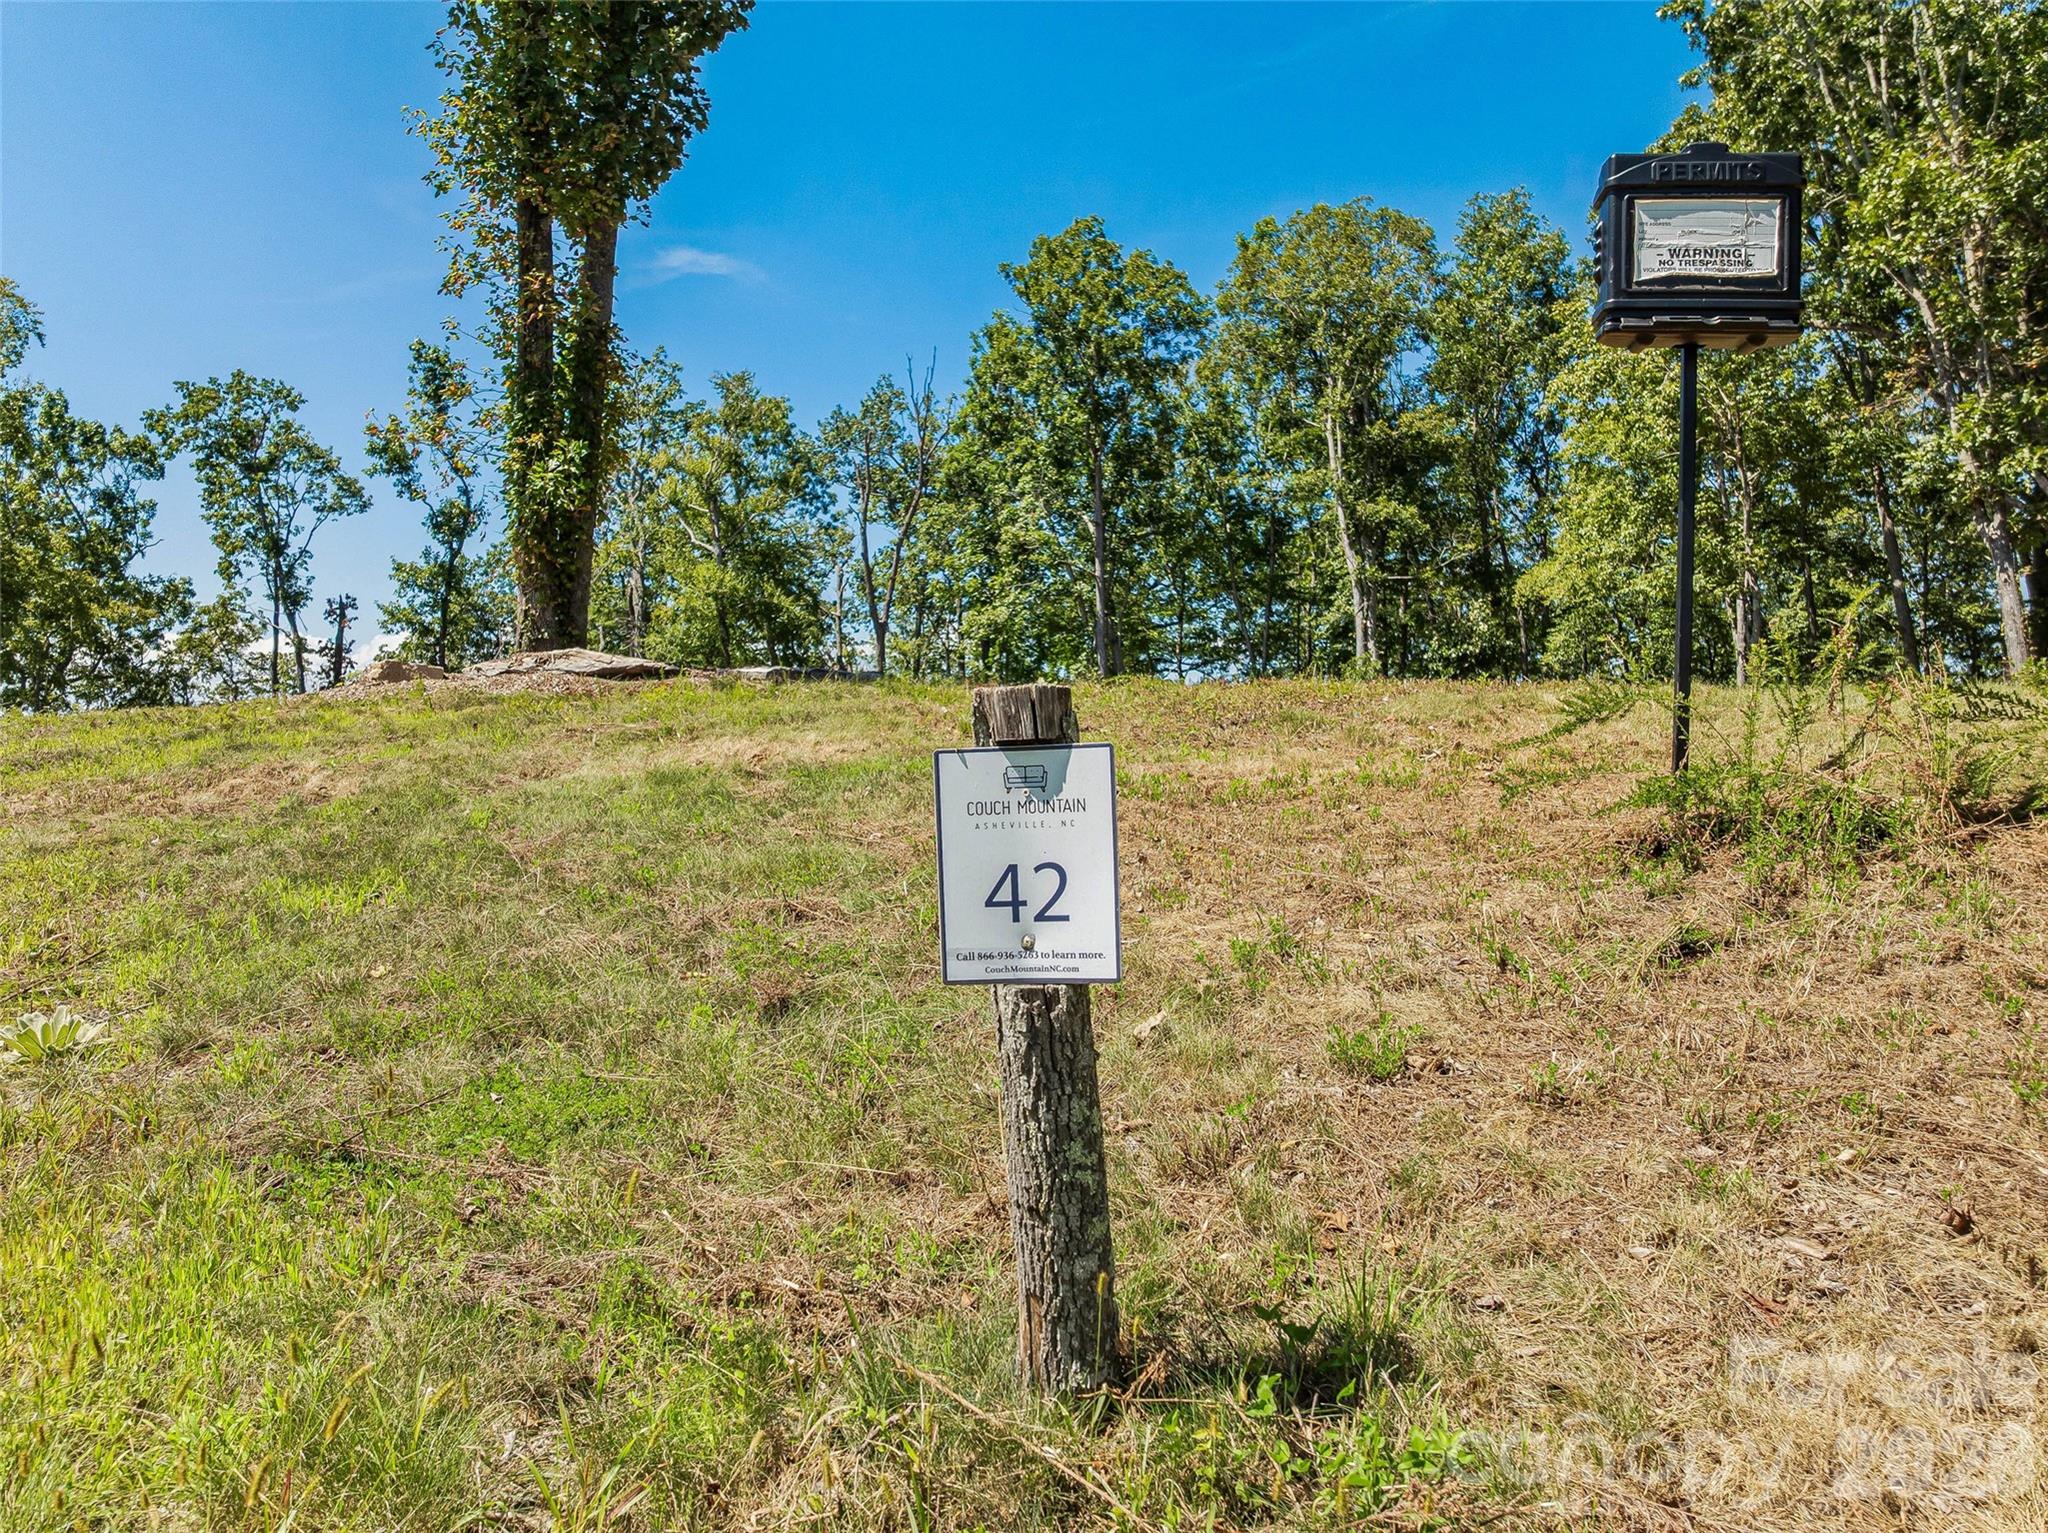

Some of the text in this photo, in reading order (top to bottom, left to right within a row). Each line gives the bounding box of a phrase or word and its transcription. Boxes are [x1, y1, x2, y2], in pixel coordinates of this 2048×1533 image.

[1655, 161, 1763, 181] PERMITS
[1668, 248, 1742, 259] WARNING
[967, 798, 1087, 816] COUCH MOUNTAIN
[1060, 819, 1076, 828] NC
[984, 861, 1070, 924] 42
[956, 949, 1107, 962] Call 866-936-5263 to learn more.
[984, 964, 1080, 974] CouchMountainNC.com
